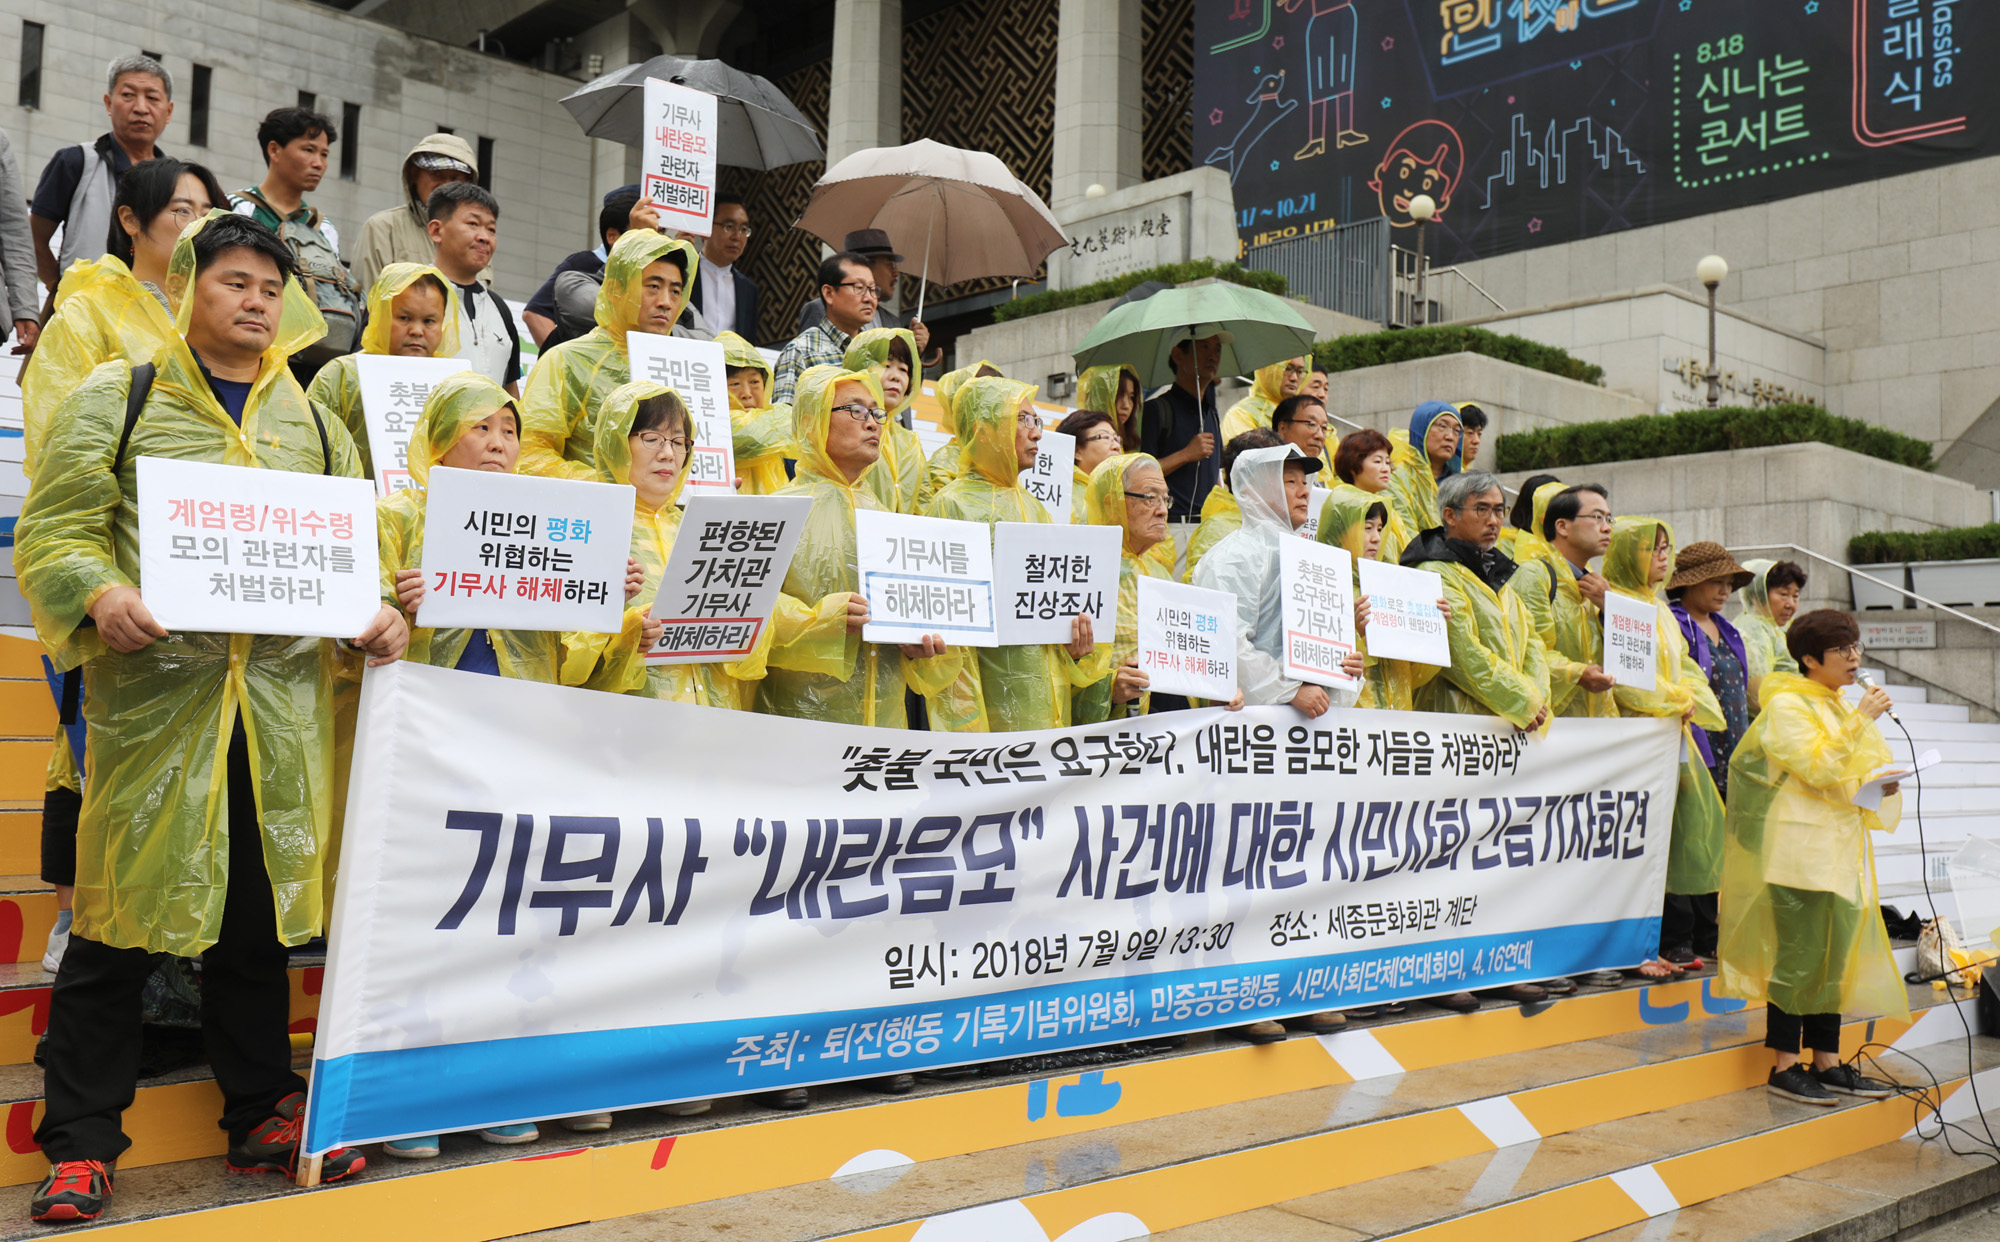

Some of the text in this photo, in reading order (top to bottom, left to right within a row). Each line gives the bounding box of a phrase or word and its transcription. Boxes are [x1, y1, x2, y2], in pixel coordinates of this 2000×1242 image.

[1696, 34, 1744, 64] 8.18
[1933, 0, 1961, 88] lassics
[1696, 54, 1810, 114] 신나는
[662, 103, 702, 131] 기무사
[655, 126, 707, 154] 내란음모
[1696, 103, 1810, 165] 콘서트
[660, 155, 700, 182] 관련자
[652, 181, 704, 210] 처벌하라
[1236, 207, 1256, 228] .17
[1277, 192, 1316, 219] 10.21
[647, 356, 712, 392] 국민을
[389, 381, 437, 407] 촛불
[167, 497, 354, 540] 계엄령/위수령
[464, 508, 593, 545] 시민의 평화
[698, 520, 786, 553] 편향된
[170, 533, 356, 574] 모의 관련자를
[478, 541, 574, 573] 위협하는
[885, 537, 970, 574] 기무사를
[1024, 554, 1092, 584] 철저한
[208, 570, 325, 606] 처벌하라
[433, 569, 608, 606] 기무사 해체하라
[684, 556, 772, 589] 가치관
[1297, 559, 1337, 589] 촛불은
[680, 592, 752, 618] 기무사
[885, 582, 976, 624] 해체하라
[1014, 590, 1104, 621] 진상조사
[1292, 583, 1345, 615] 요구한다
[1370, 594, 1440, 618] 평화로운 촛불집회
[1157, 607, 1218, 634] 시민의 평화
[1297, 608, 1343, 641] 기무사
[1371, 611, 1406, 629] 계엄령이
[1611, 614, 1652, 638] 계엄령/위수령
[658, 624, 750, 651] 해체하라
[1165, 631, 1211, 654] 위협하는
[1611, 632, 1652, 656] 모의 관련자를
[1146, 650, 1230, 679] 기무사 해체하라
[1293, 639, 1347, 671] 해체하라
[1619, 652, 1645, 672] 처벌하라
[841, 723, 1528, 792] "촛불 국민은 요구한다. 내란을 음모한 자들을 처벌하라"
[434, 809, 709, 937] 기무사
[732, 806, 1045, 920] “내란음모”
[1055, 801, 1215, 900] 사건에
[1222, 800, 1315, 890] 대한
[1322, 798, 1471, 882] 시민사회
[1269, 894, 1478, 947] 장소: 세종문화회관 계단
[885, 921, 1235, 989] 일시: 2018년 7월 9일 13:30
[726, 939, 1534, 1076] 주최: 퇴진행동 기록기념위원회, 민중공동행동, 시민사회단체연대회의, 4.16연대
